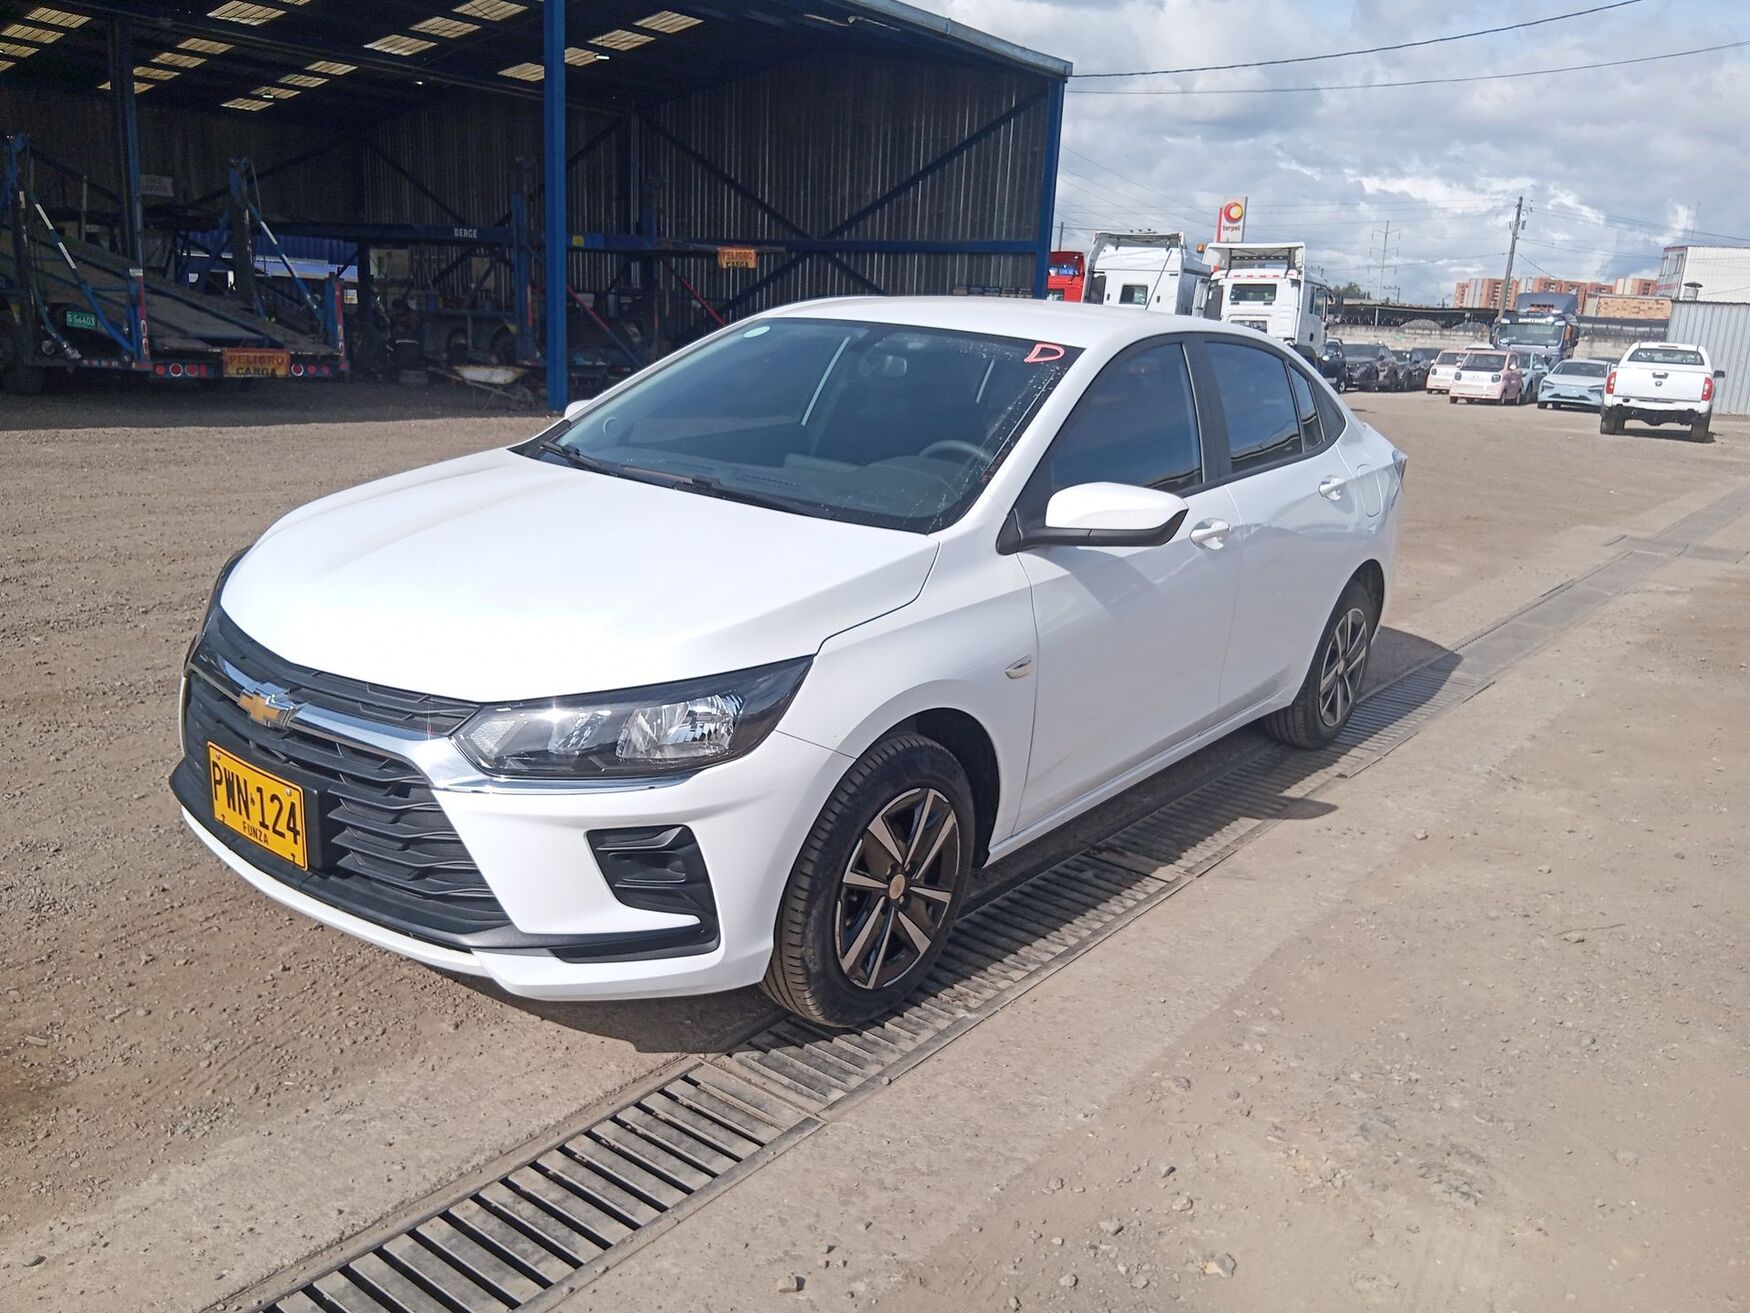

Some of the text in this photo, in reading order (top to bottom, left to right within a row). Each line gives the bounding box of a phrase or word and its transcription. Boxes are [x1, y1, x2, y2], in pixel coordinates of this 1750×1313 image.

[454, 227, 478, 239] BERGE
[721, 250, 753, 260] PELIGRO
[1023, 343, 1065, 363] D
[229, 353, 285, 366] PELIGRO
[235, 367, 277, 378] CARGA
[242, 820, 269, 845] FUNZA
